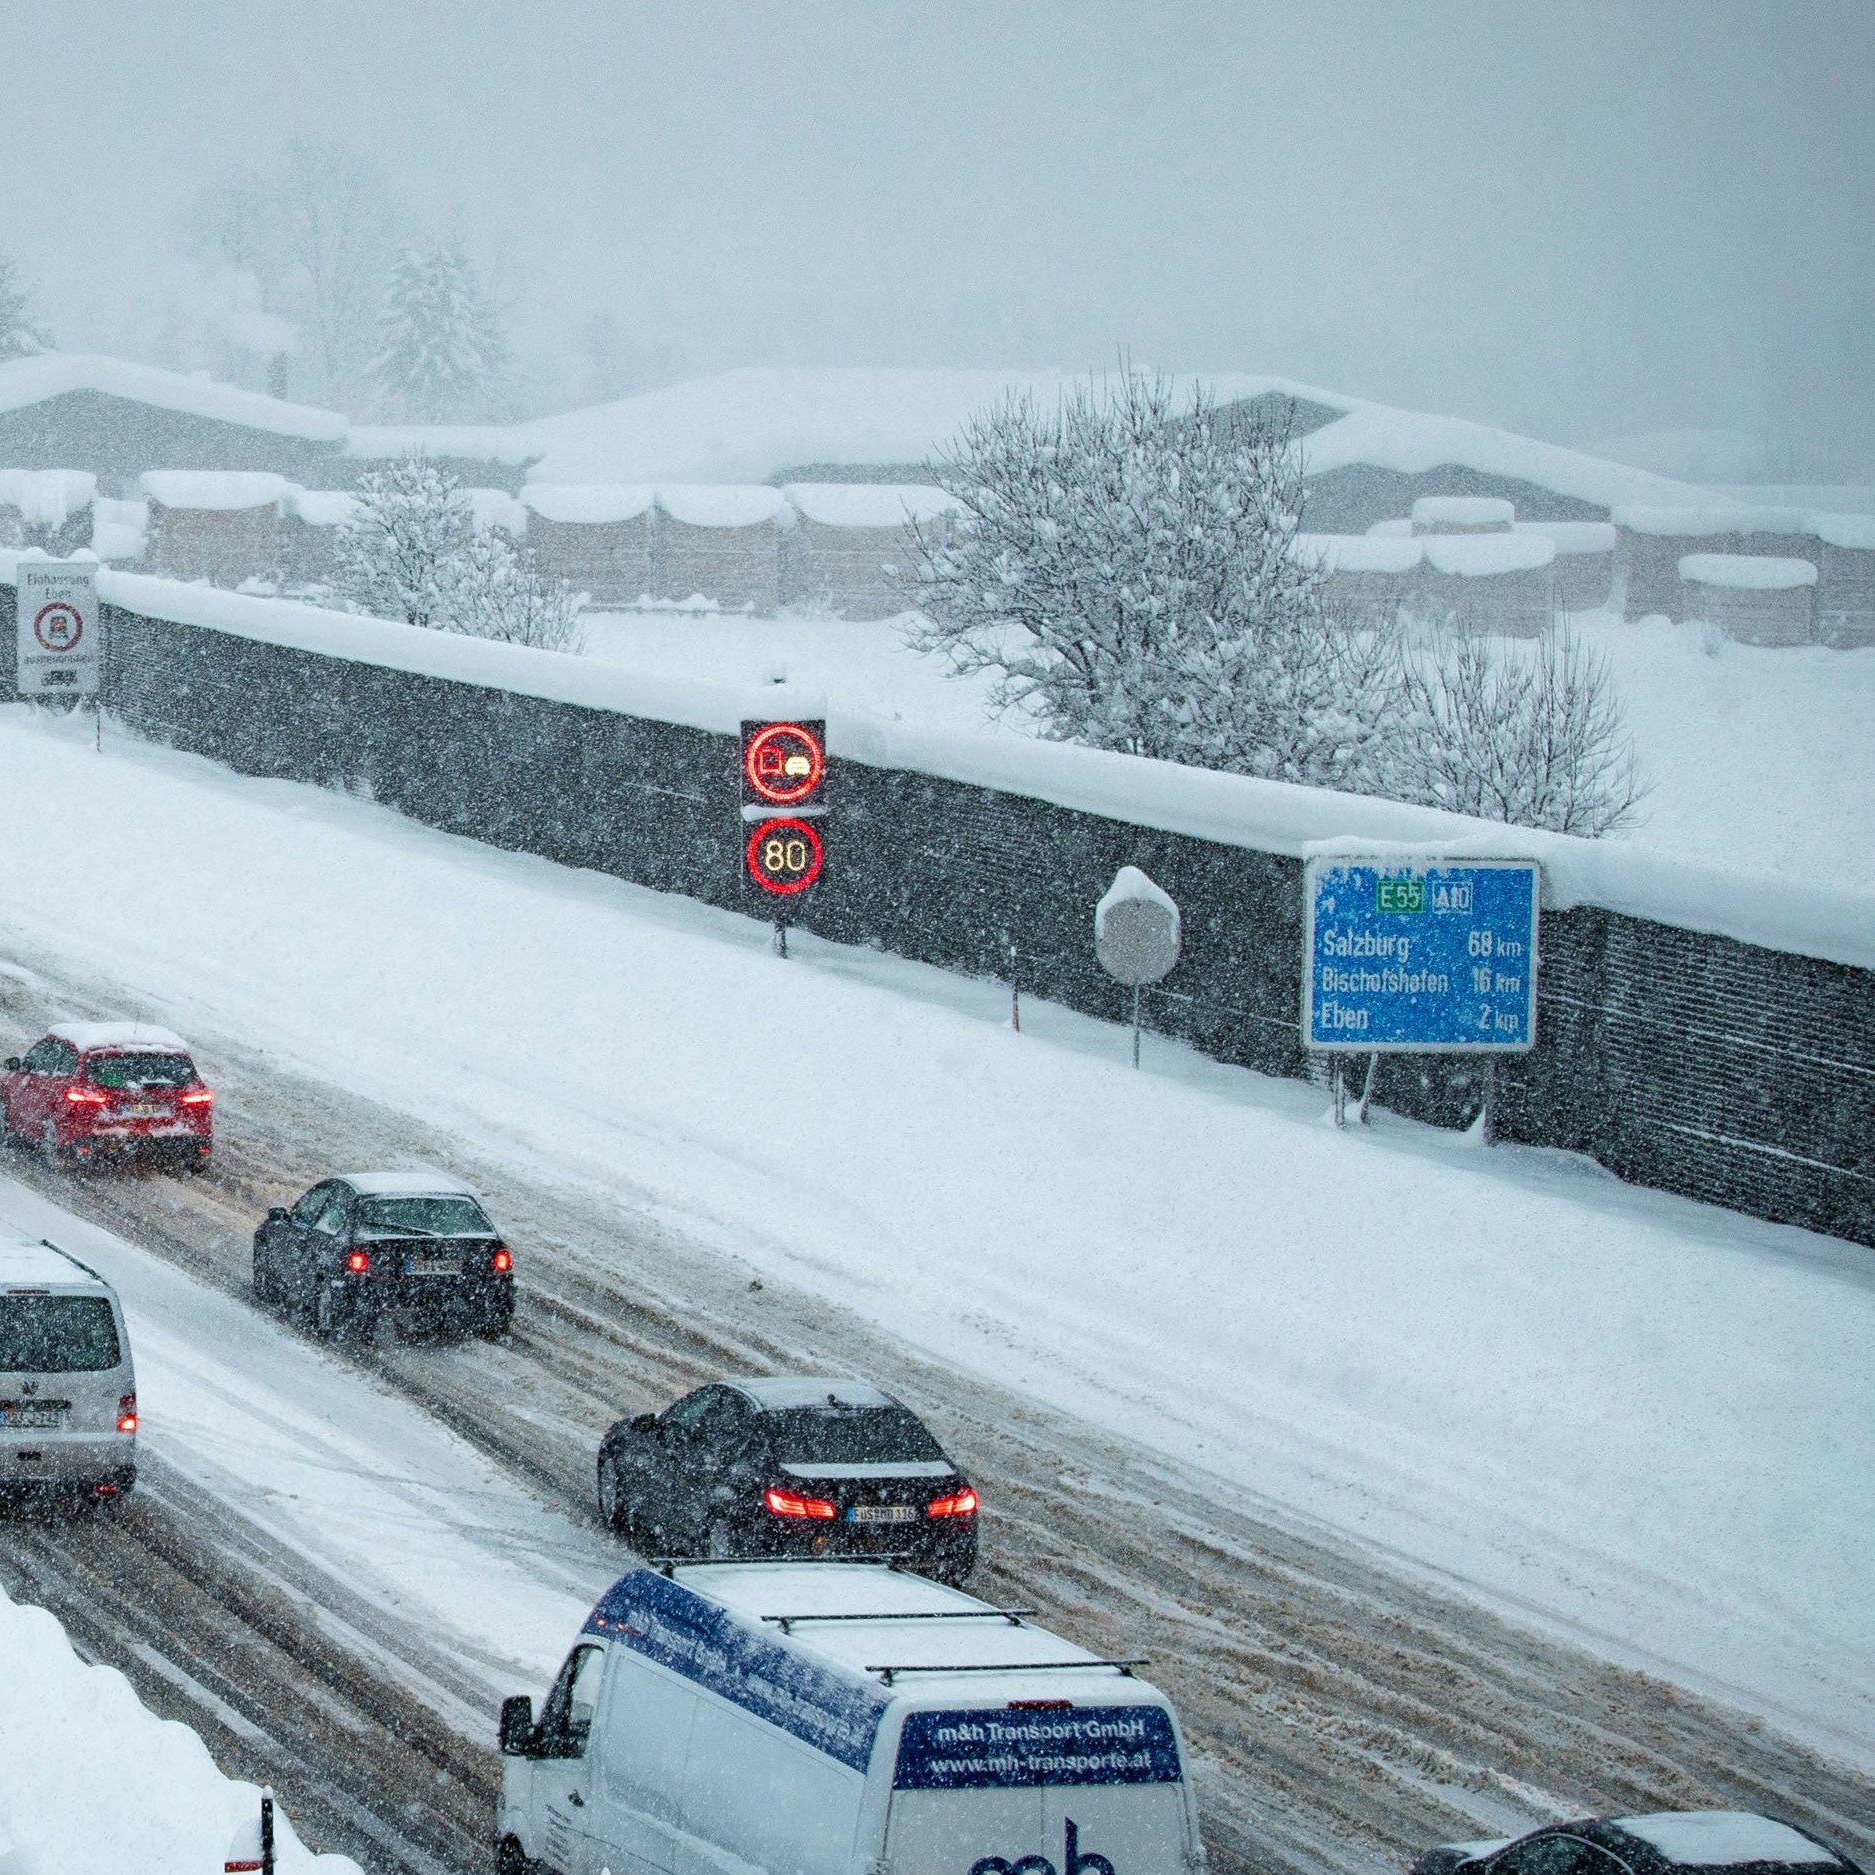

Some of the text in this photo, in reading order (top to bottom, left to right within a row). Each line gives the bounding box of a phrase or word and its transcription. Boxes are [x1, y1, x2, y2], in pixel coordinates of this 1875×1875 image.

[765, 839, 806, 871] 80
[1323, 928, 1521, 963] Salzburg 68 km
[1322, 966, 1520, 993] Bischofshofen 16 km
[1321, 1001, 1519, 1030] Eben 2 km
[937, 1719, 1145, 1742] m&h Transport GmbH
[929, 1751, 1151, 1774] www.mh-transporte.at
